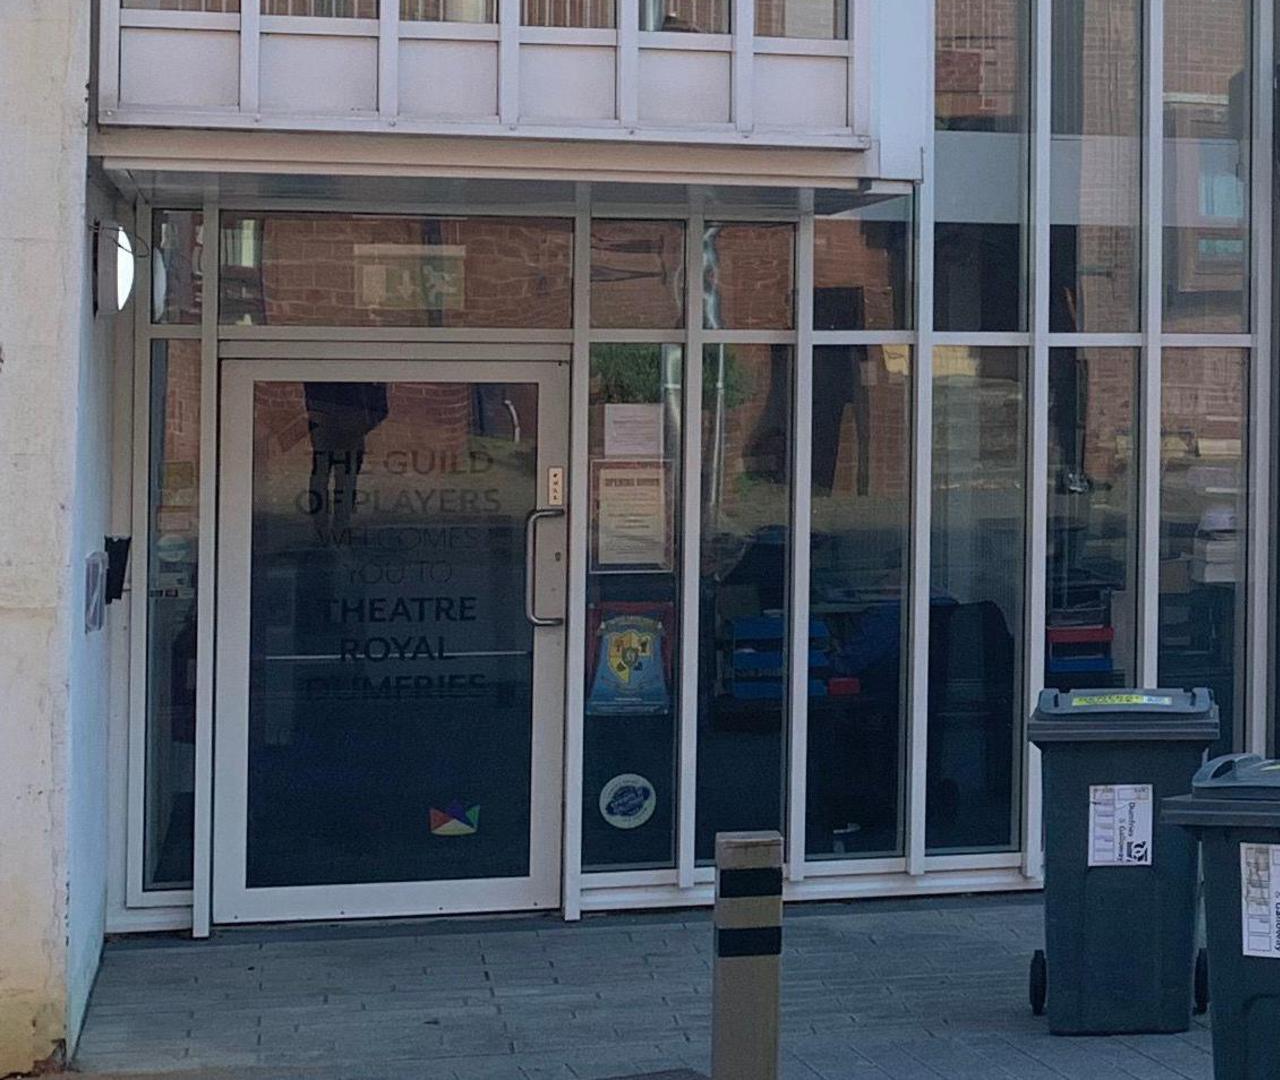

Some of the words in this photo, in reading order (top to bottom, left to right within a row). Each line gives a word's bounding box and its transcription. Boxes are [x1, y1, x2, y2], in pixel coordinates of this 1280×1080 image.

[306, 450, 378, 477] THE
[382, 449, 495, 476] GUILD
[354, 487, 501, 514] PLAYERS
[319, 597, 478, 622] THEATRE
[340, 636, 456, 663] ROYAL
